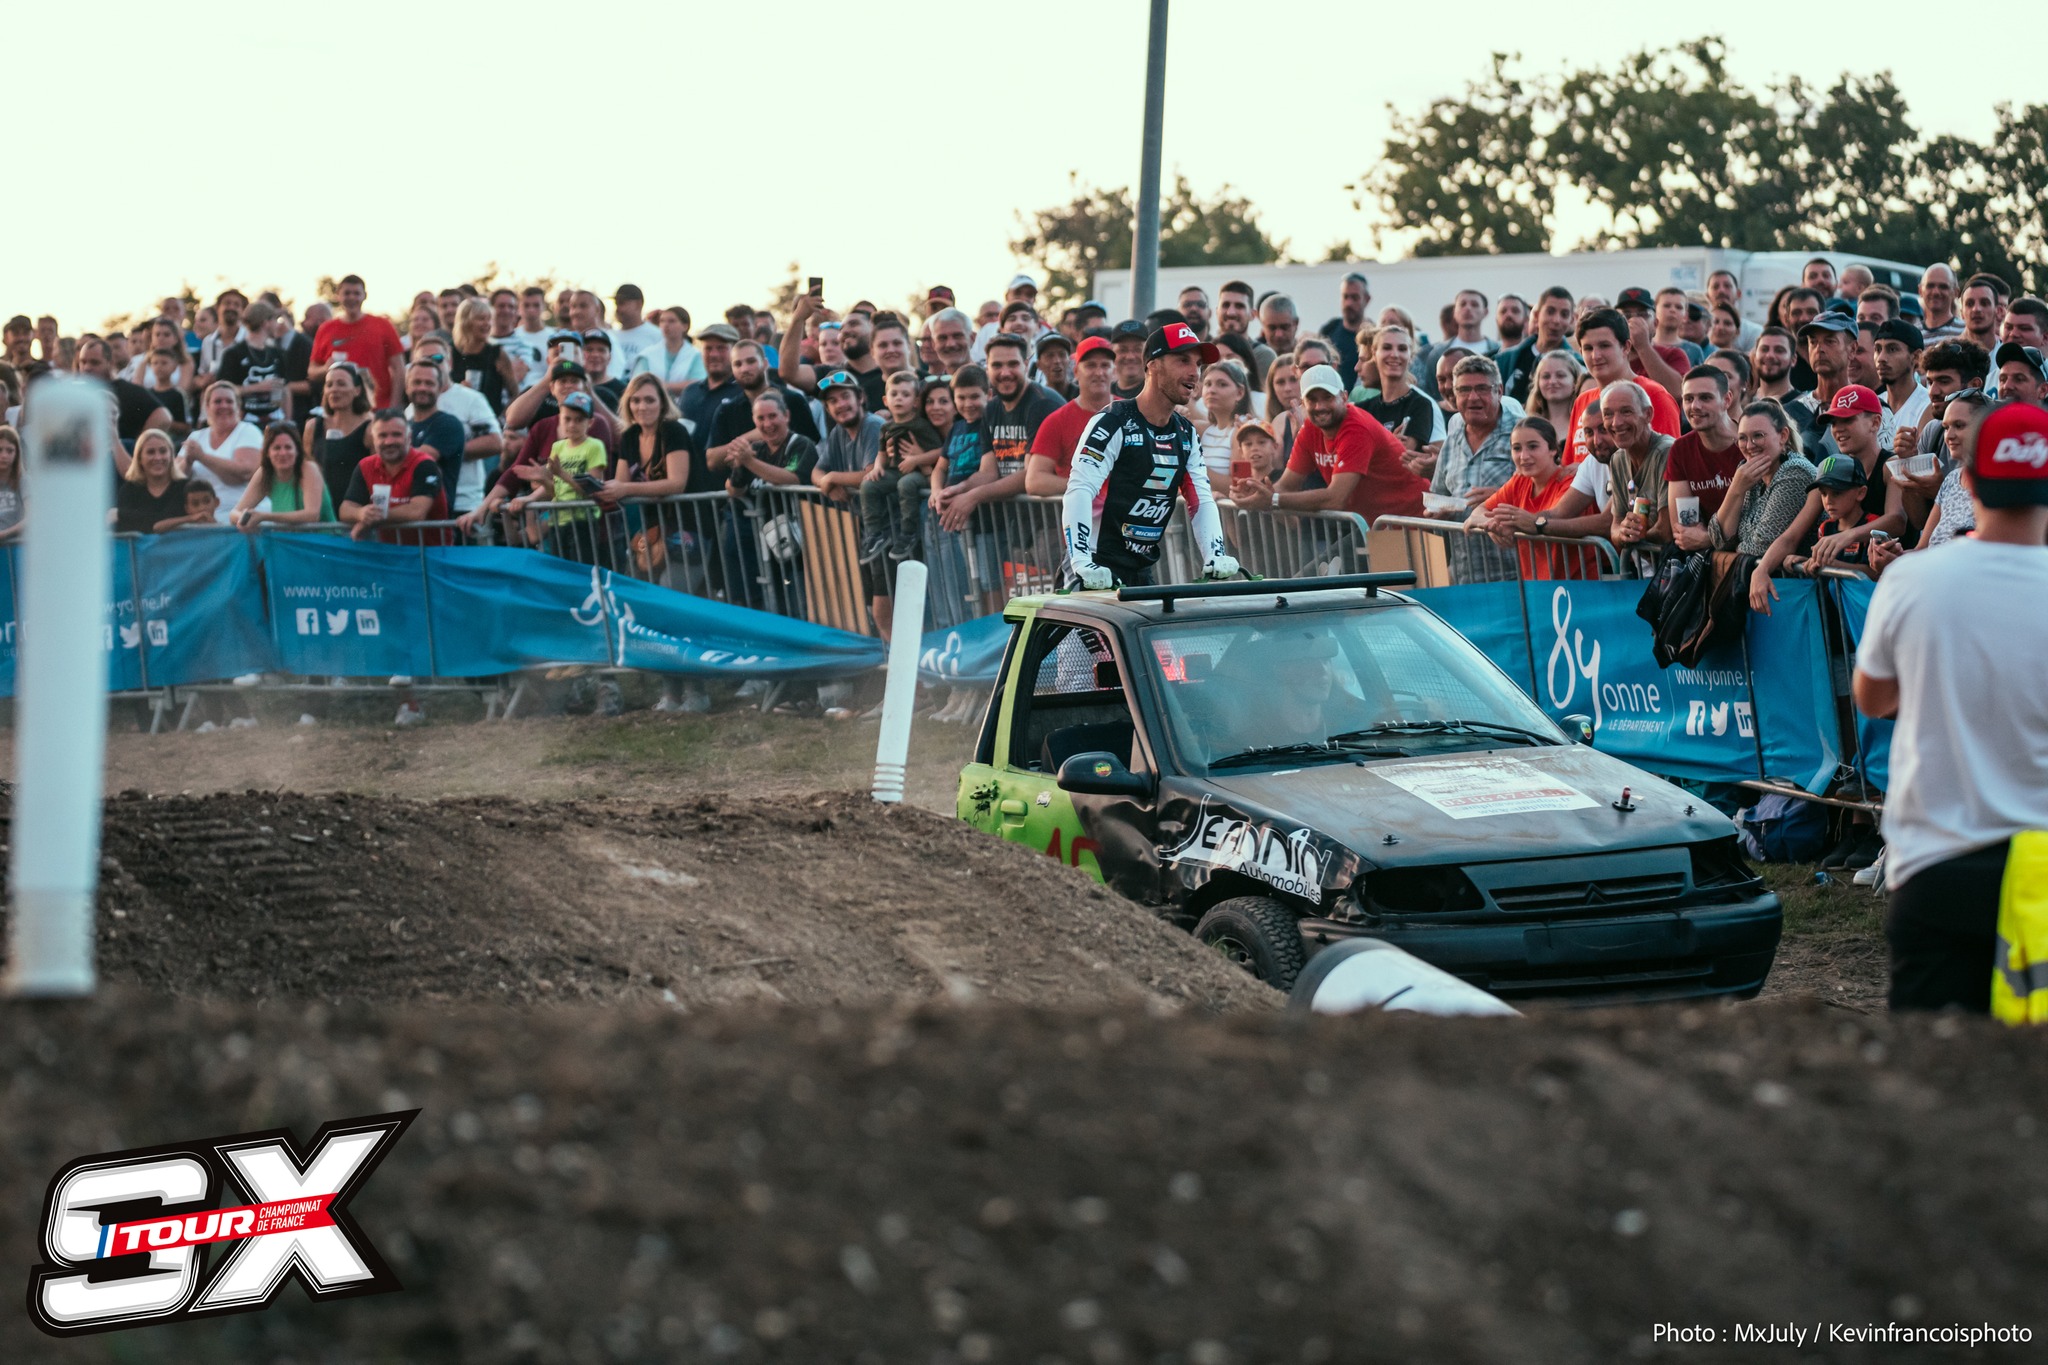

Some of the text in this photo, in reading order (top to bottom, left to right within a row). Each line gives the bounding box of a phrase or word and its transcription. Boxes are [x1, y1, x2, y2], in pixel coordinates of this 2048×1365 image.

[1128, 498, 1172, 524] Dafy
[1074, 522, 1090, 555] Dafy
[283, 582, 385, 602] www.yonne.fr
[1675, 669, 1754, 692] www.yonne.r
[1608, 718, 1665, 733] LE DÉPARTEMENT
[1238, 862, 1321, 903] Automobiles
